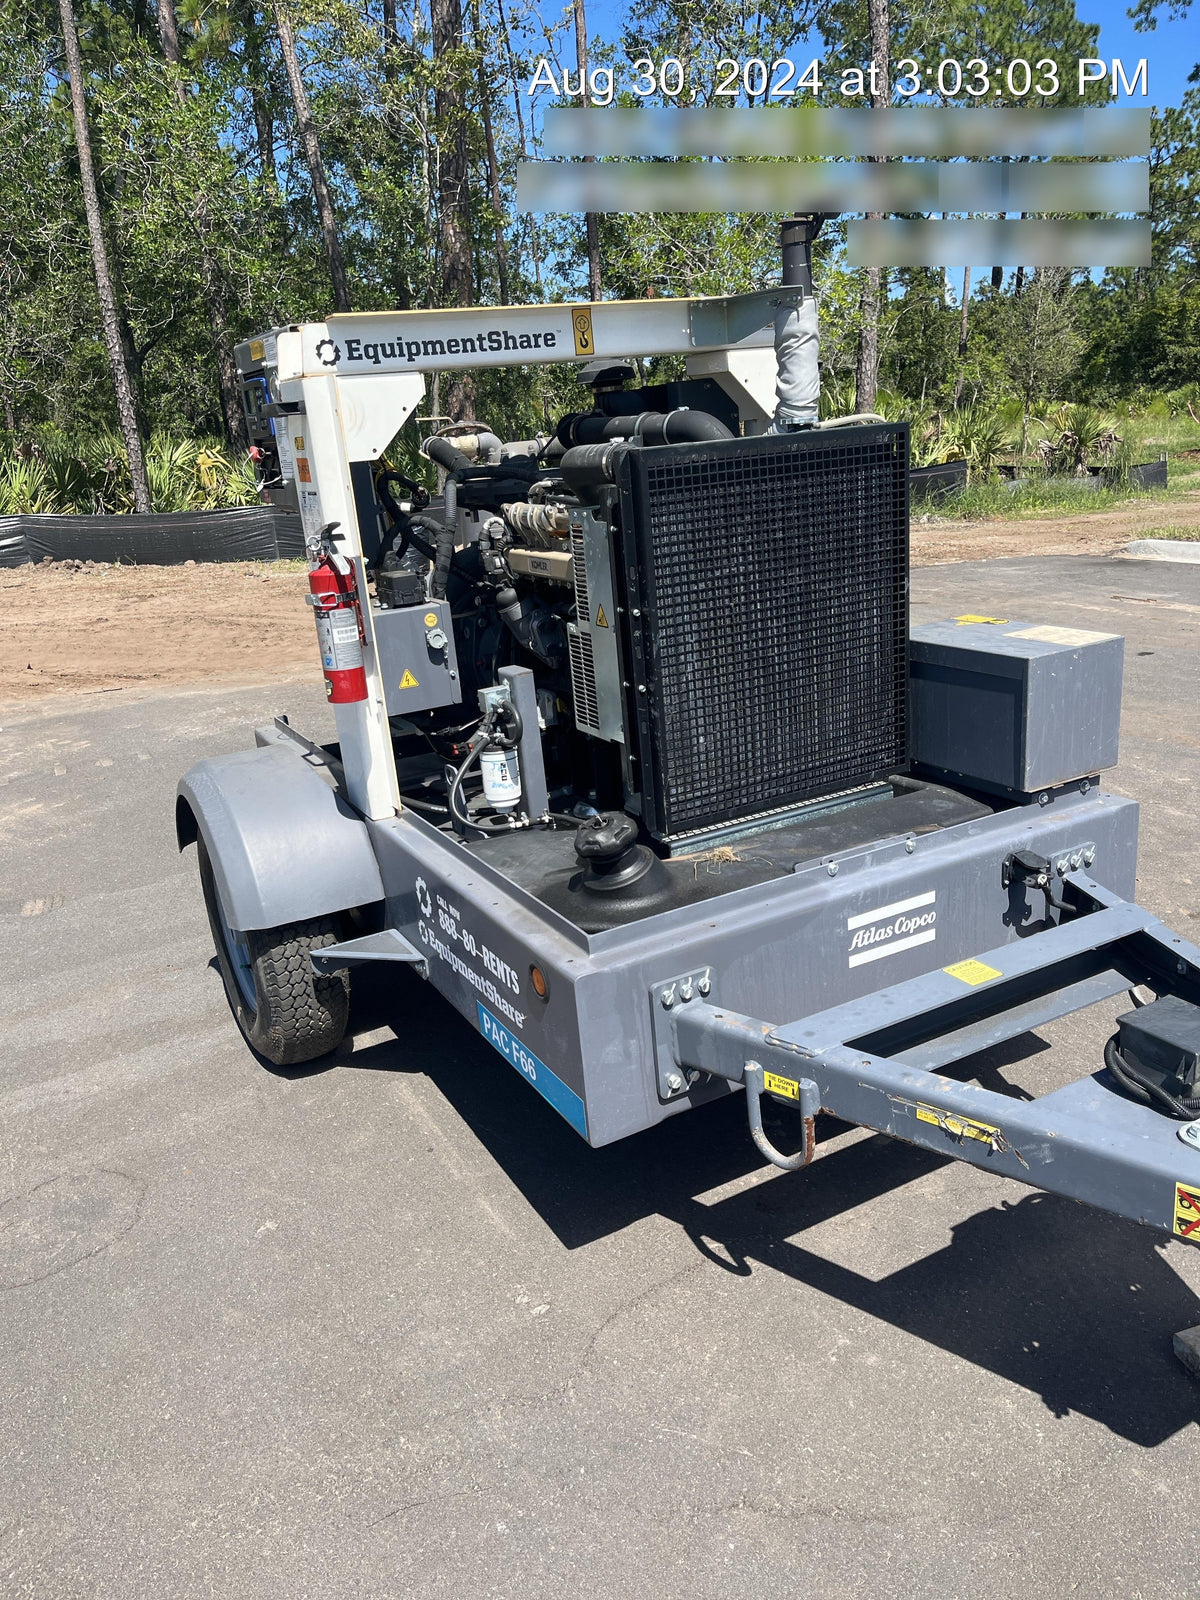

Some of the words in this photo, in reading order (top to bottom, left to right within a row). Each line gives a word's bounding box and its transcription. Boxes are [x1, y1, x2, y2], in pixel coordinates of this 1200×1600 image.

[344, 330, 557, 365] EquipmentShare
[848, 927, 894, 951] Atlas
[894, 911, 937, 934] Copco
[438, 908, 520, 995] 888-80-RENTS
[428, 927, 524, 1029] EquipmentShare
[482, 1012, 510, 1054] PAC
[511, 1040, 537, 1081] F66
[773, 1083, 789, 1092] HERE
[777, 1077, 795, 1088] DOWN
